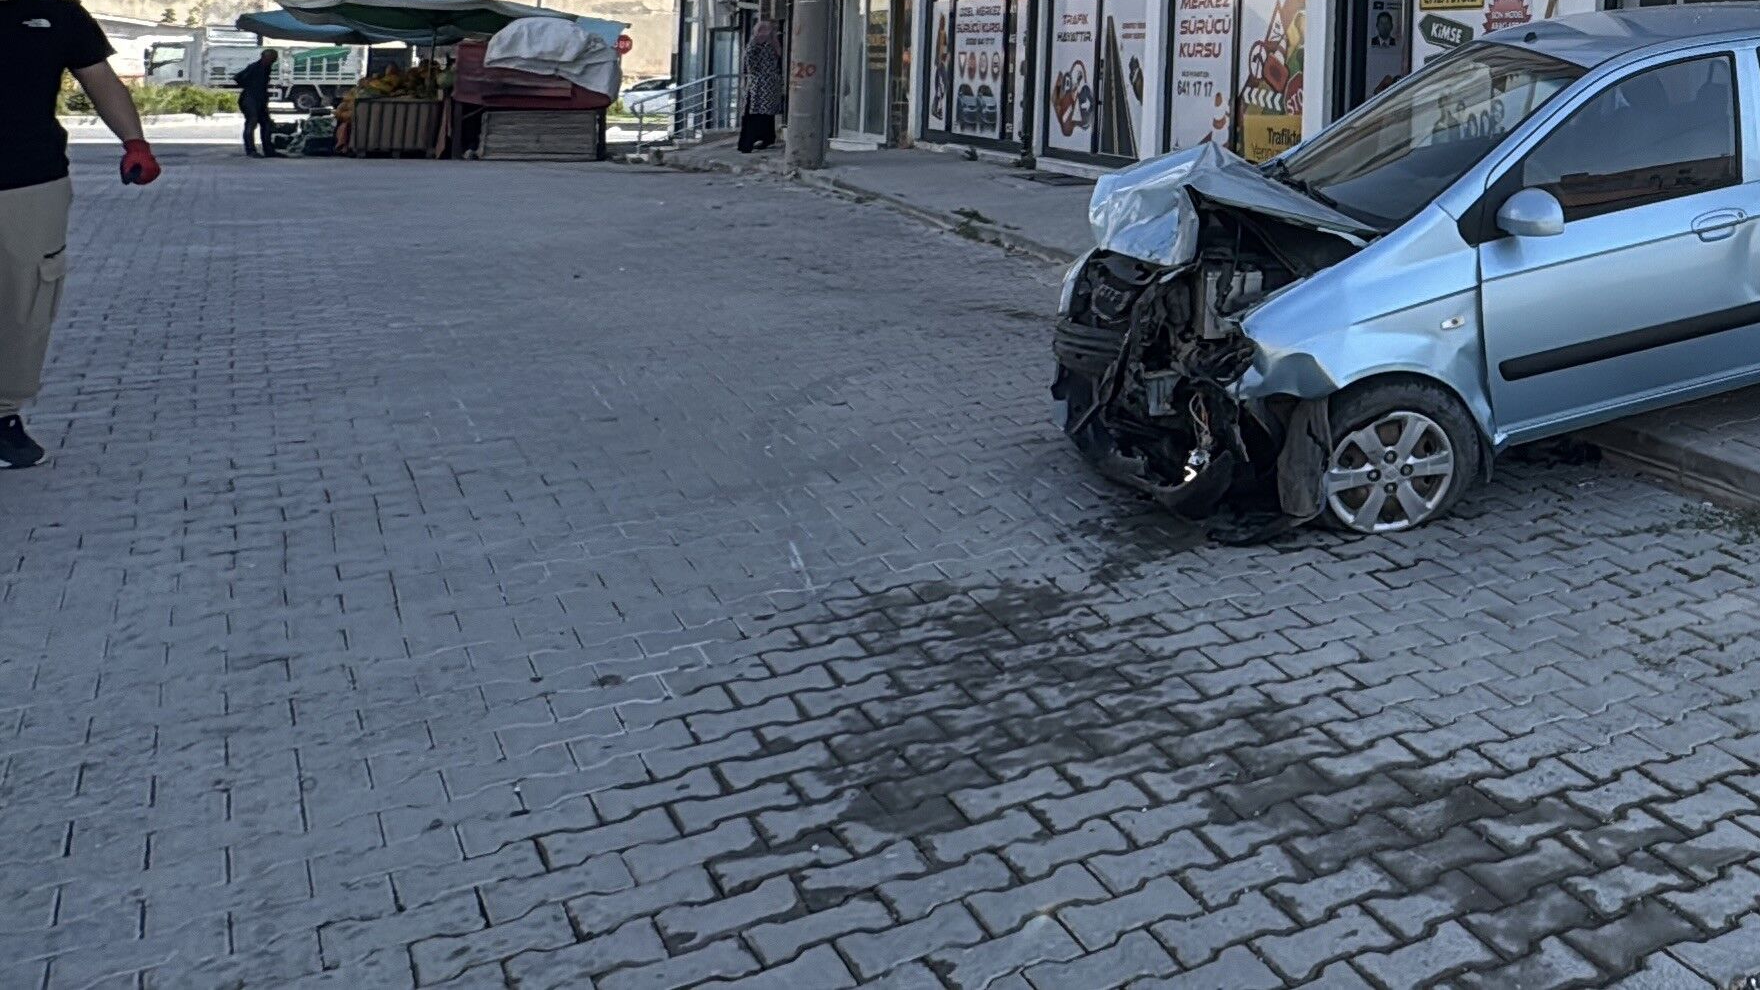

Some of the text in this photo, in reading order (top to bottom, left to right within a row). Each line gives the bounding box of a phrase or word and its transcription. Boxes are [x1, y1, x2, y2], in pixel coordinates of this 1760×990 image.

[1179, 14, 1232, 35] SÜRÜCÜ
[1178, 42, 1222, 58] KURSU
[1177, 79, 1213, 97] 641 17 17
[1287, 88, 1303, 115] STO
